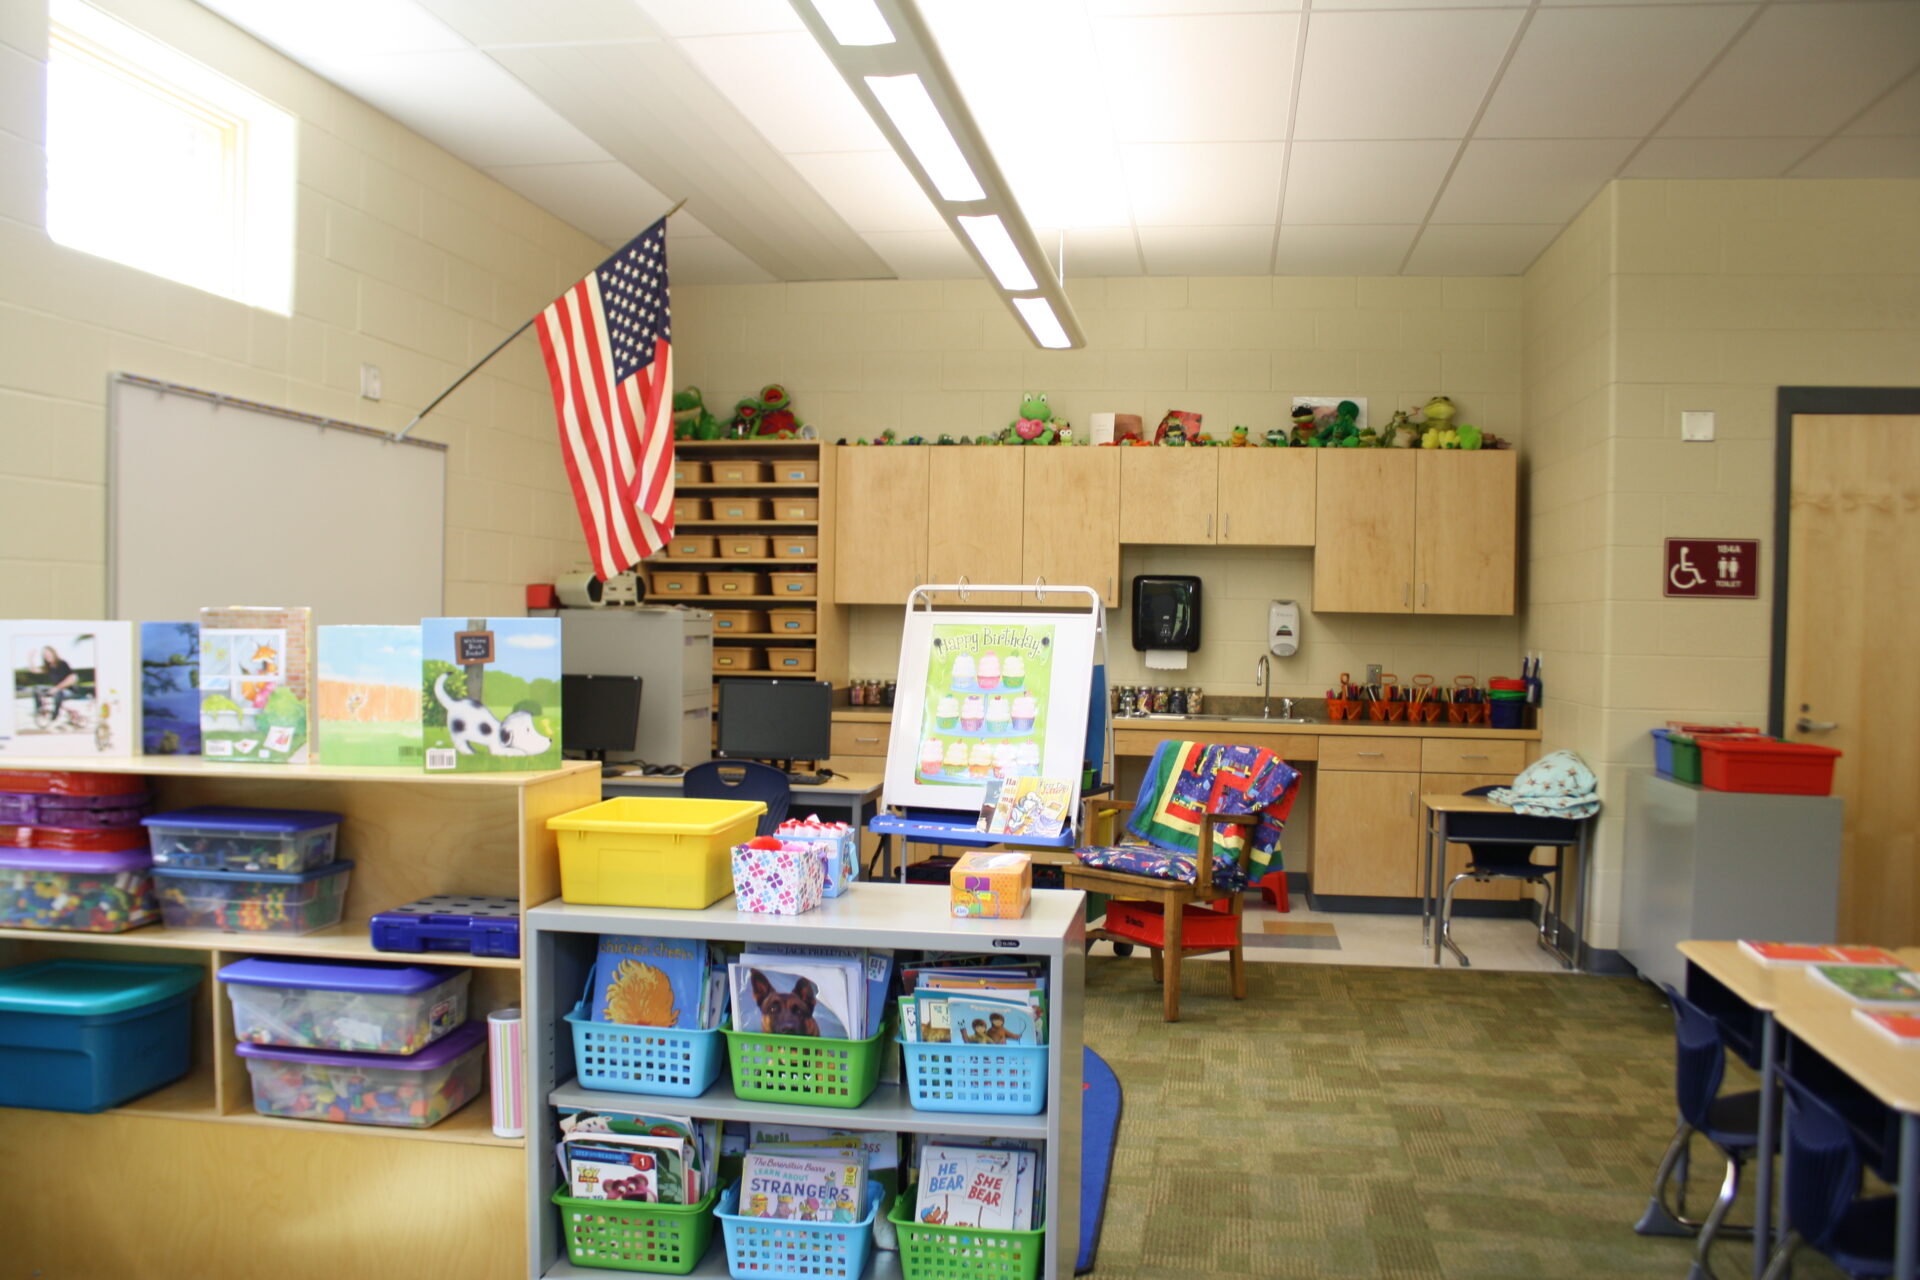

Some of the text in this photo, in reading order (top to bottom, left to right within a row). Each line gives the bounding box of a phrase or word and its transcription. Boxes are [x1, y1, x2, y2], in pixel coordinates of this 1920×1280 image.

[1715, 580, 1742, 588] TOILET
[938, 632, 979, 655] Happy
[639, 1157, 646, 1167] 1
[753, 1156, 766, 1166] The
[804, 1162, 826, 1173] Bears
[937, 1162, 959, 1176] HE
[577, 1166, 601, 1178] TOY
[754, 1168, 809, 1182] LEARN ABOUT
[750, 1178, 850, 1201] STRANGERS
[929, 1174, 964, 1193] BEAR
[974, 1172, 1003, 1190] SHE
[967, 1186, 1001, 1207] BEAR
